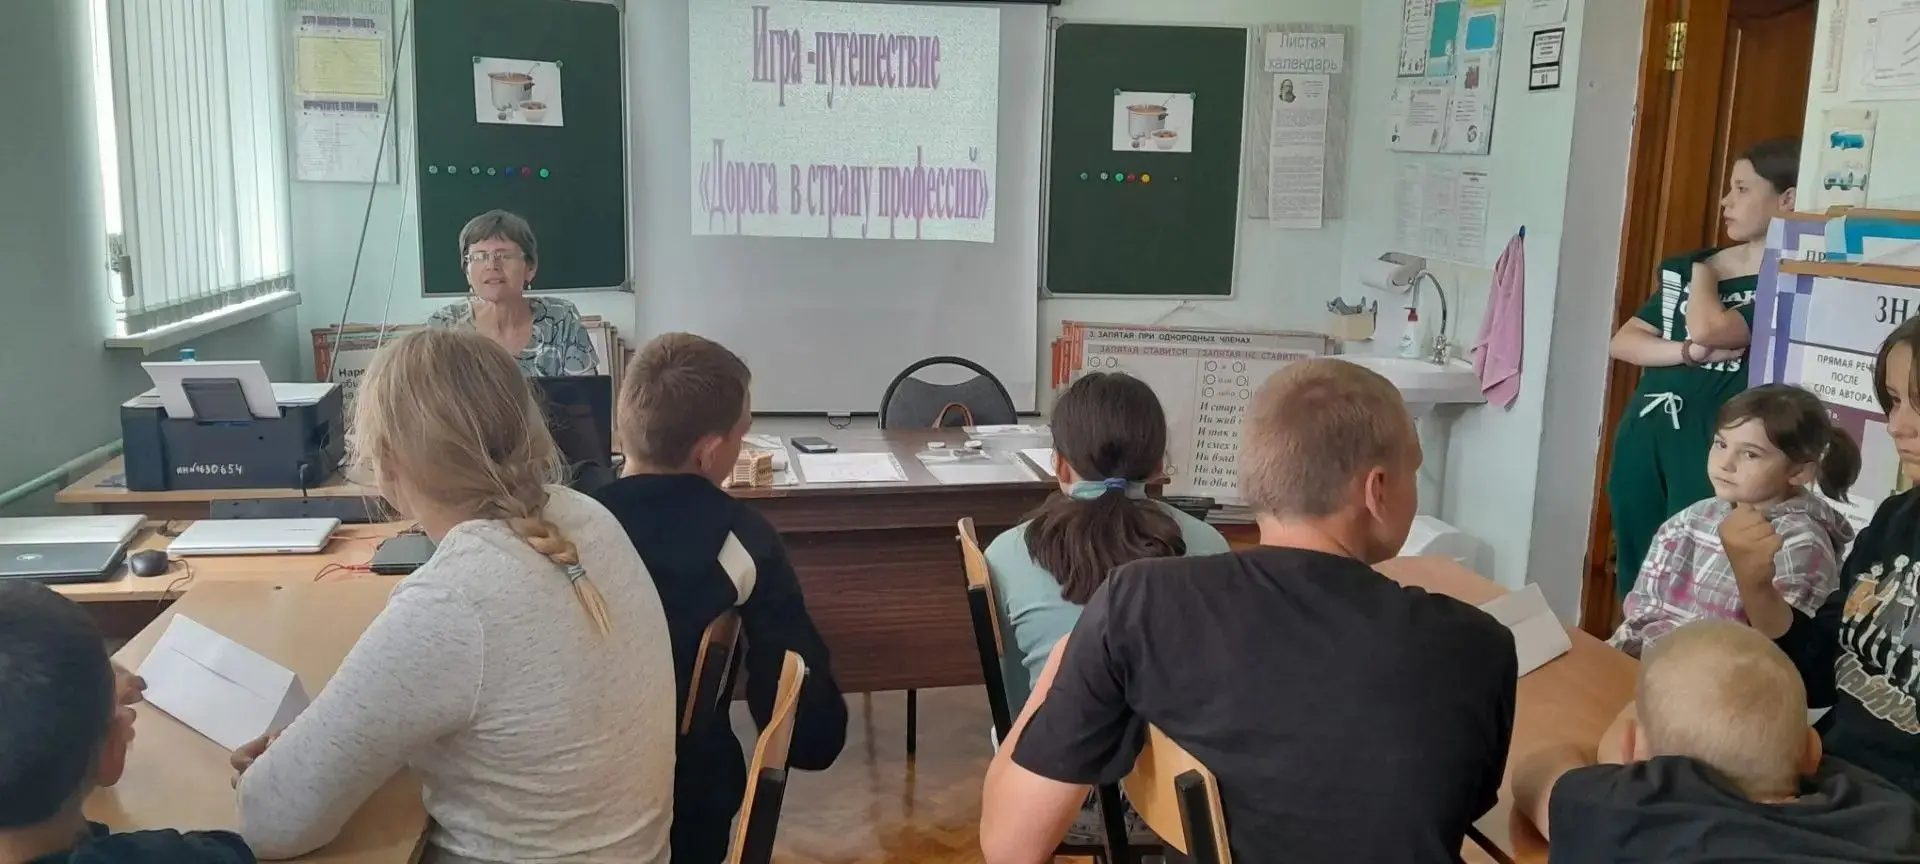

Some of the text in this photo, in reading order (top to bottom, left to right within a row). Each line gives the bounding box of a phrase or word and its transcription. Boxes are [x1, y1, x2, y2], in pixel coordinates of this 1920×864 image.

[1280, 33, 1326, 49] Листая
[751, 5, 803, 107] Игра
[1268, 57, 1338, 73] календарь
[700, 139, 989, 239] «Дорога в страну профессий»
[1875, 295, 1920, 325] ЗН
[1098, 331, 1134, 339] ЗАПЯТАЯ
[1139, 332, 1154, 341] ПРИ
[1159, 333, 1215, 342] ОДНОРОДНЫХ
[1220, 335, 1250, 344] ЧЛЕНАХ
[1101, 345, 1188, 357] ЗАПЯТАЯ СТАВИТСЯ
[1202, 349, 1241, 359] ЗАПЯТАЯ
[1246, 351, 1255, 360] НЕ
[1817, 354, 1853, 368] ПРЯМАЯ
[1831, 372, 1859, 385] ПОСЛЕ
[1814, 384, 1873, 403] СЛОВ АВТОРА
[1211, 404, 1236, 415] стар
[1199, 415, 1212, 424] Ни
[1216, 416, 1237, 424] жив
[1207, 442, 1230, 450] смех
[1196, 452, 1235, 462] Ни взад
[1194, 465, 1208, 474] Ни
[1211, 465, 1222, 475] да
[1193, 477, 1209, 486] Ни
[1210, 477, 1228, 488] два
